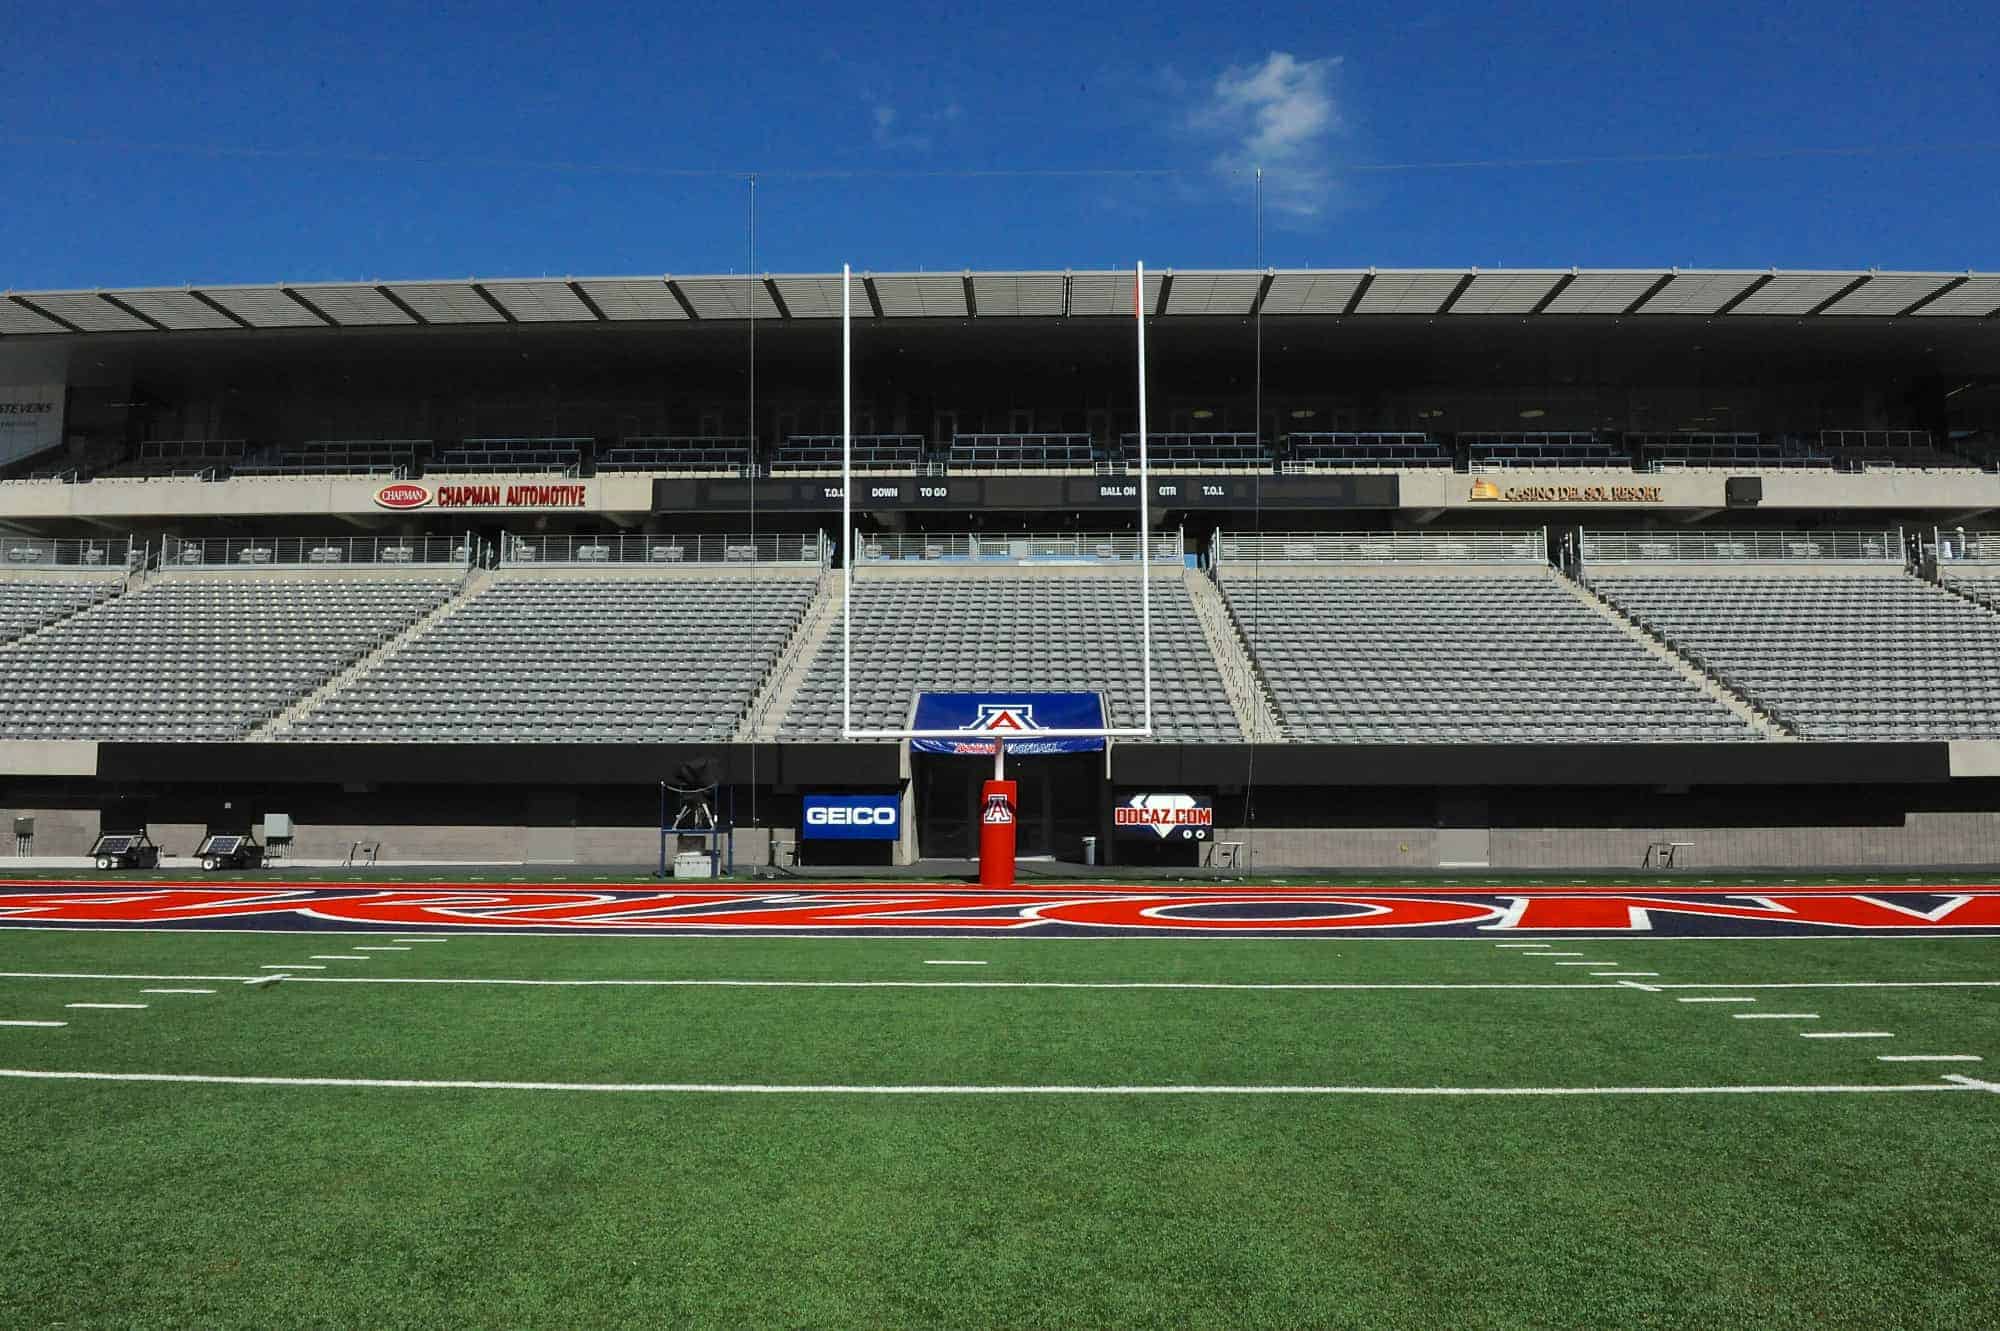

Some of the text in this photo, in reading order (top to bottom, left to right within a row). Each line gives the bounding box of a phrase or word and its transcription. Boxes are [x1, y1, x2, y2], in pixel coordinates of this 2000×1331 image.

[382, 490, 423, 500] CHAPMAN
[871, 487, 898, 497] DOWN
[920, 487, 947, 497] TO GO
[1100, 486, 1136, 496] BALL ON
[1158, 486, 1176, 496] QTR
[1504, 487, 1662, 501] CASINO DEL SOL RESORT
[437, 486, 586, 507] CHAPMAN AUTOMOTIVE
[806, 807, 896, 825] GEICO
[0, 889, 2000, 931] ARIZON
